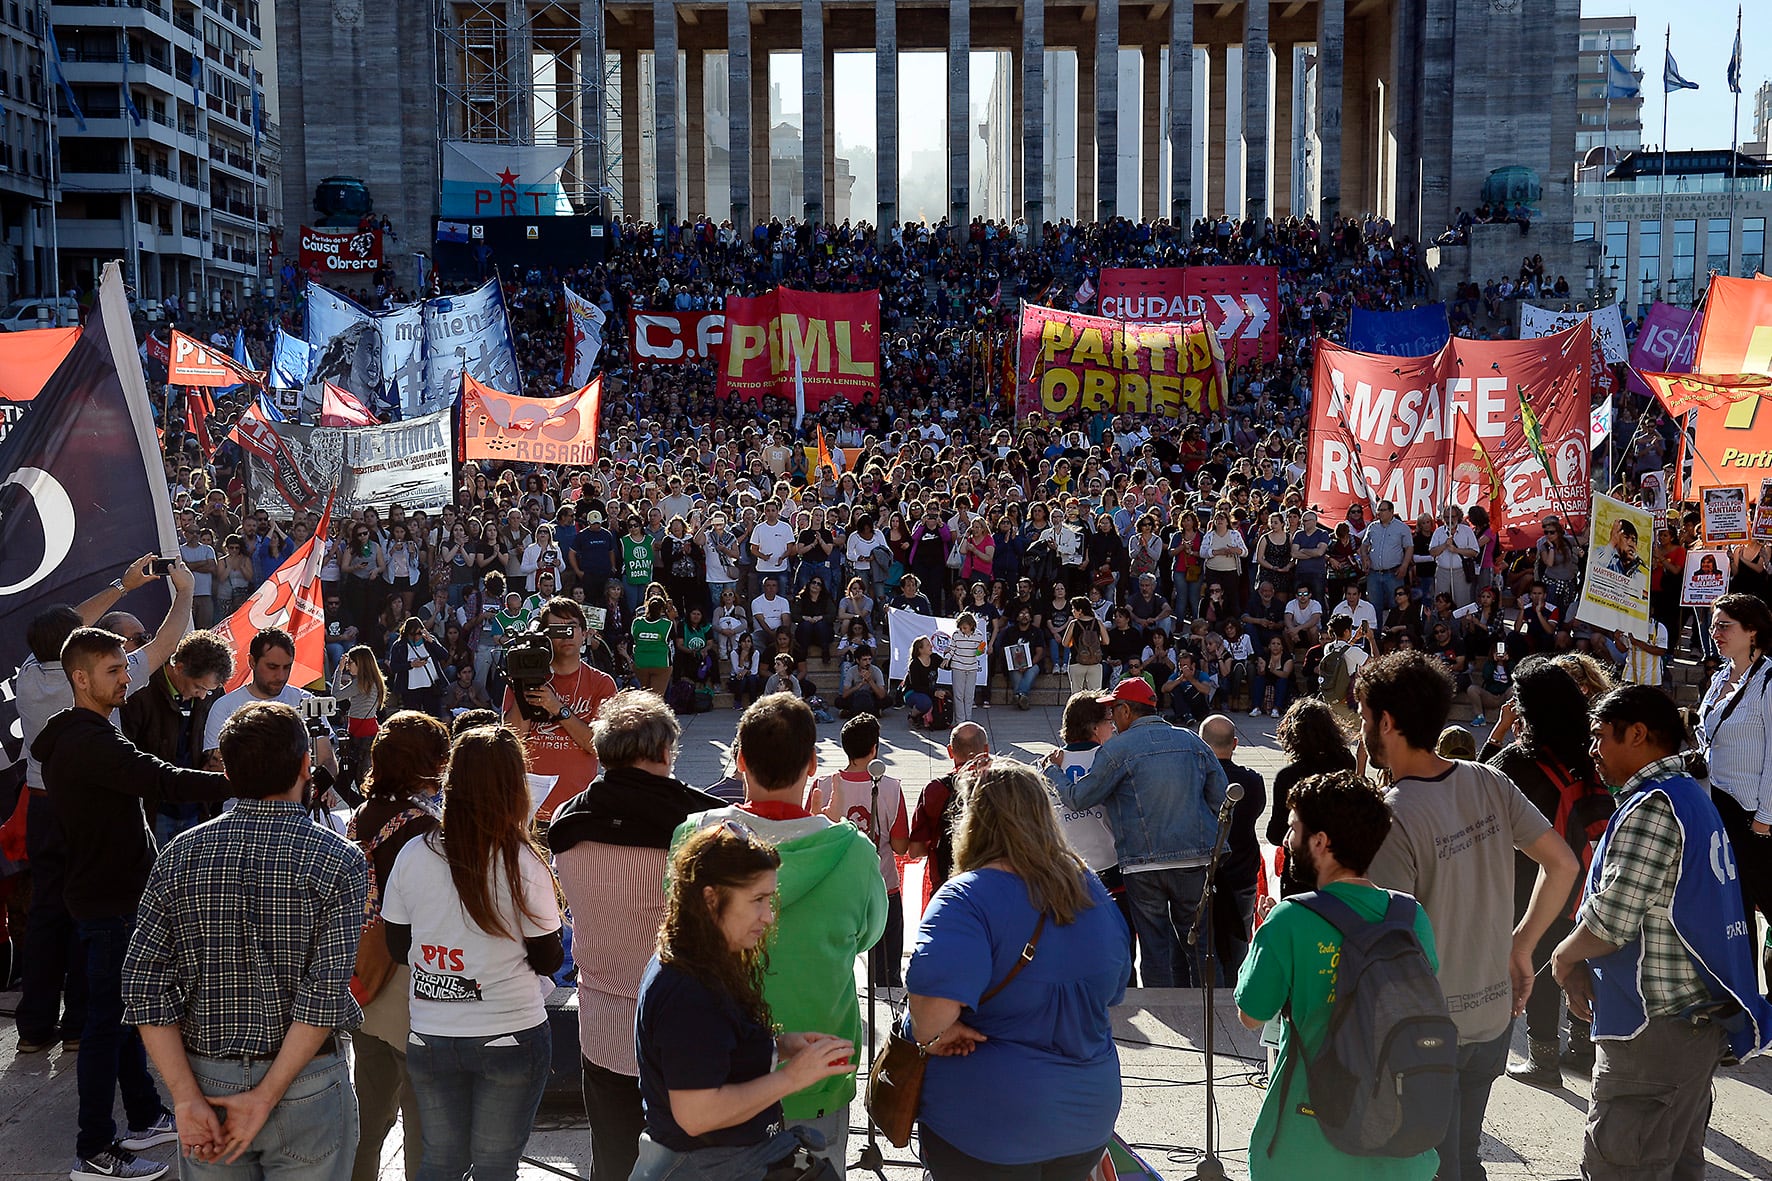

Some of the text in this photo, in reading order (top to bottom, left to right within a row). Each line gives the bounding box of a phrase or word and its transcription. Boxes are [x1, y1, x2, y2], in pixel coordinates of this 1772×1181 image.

[474, 189, 548, 216] PRT
[302, 235, 339, 254] Causa
[312, 233, 332, 243] Partido
[326, 255, 378, 270] Obrera
[1101, 295, 1206, 318] CIUDAD
[727, 380, 762, 388] PARTIDO
[833, 378, 876, 388] LENINISTA
[1326, 367, 1508, 449] AMSAFE
[239, 415, 279, 451] PTS
[404, 458, 410, 467] Y
[1708, 506, 1742, 514] SANTIAGO
[566, 626, 573, 636] 5
[421, 944, 465, 972] PTS
[414, 969, 460, 992] FRENTE
